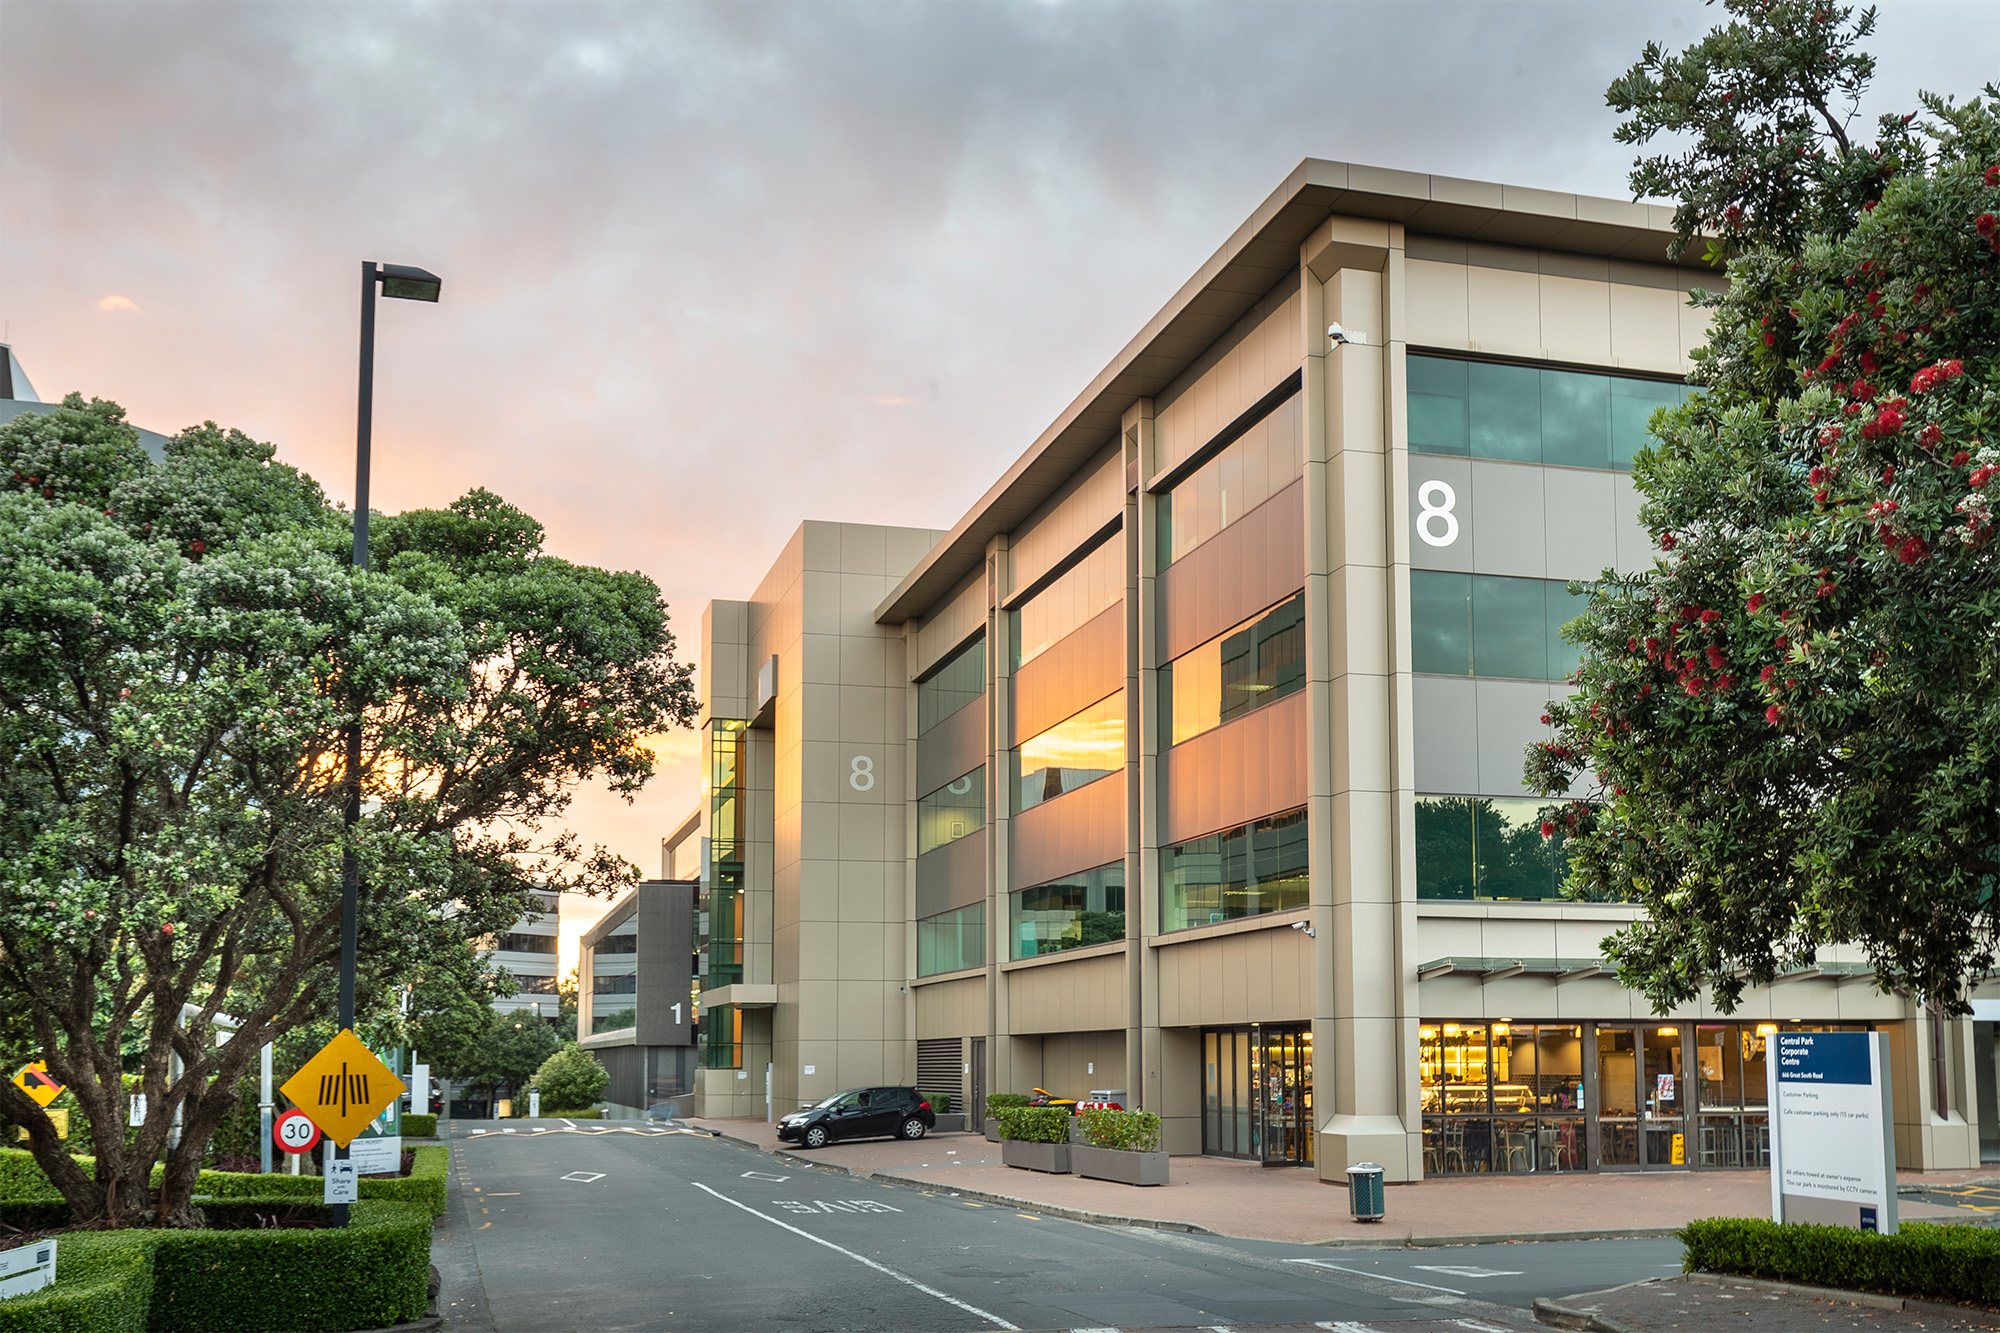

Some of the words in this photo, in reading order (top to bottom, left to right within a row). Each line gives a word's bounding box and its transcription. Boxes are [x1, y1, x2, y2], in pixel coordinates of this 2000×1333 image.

[1416, 479, 1459, 547] 8
[849, 755, 875, 792] 8
[670, 1002, 681, 1025] 1
[1780, 1036, 1800, 1045] Central
[1801, 1036, 1814, 1045] Park
[1780, 1046, 1809, 1057] Corporate
[1781, 1057, 1800, 1066] Centre
[1801, 1071, 1812, 1079] South
[1803, 1092, 1819, 1100] Parking
[285, 1123, 310, 1139] 30
[331, 1177, 351, 1185] Share
